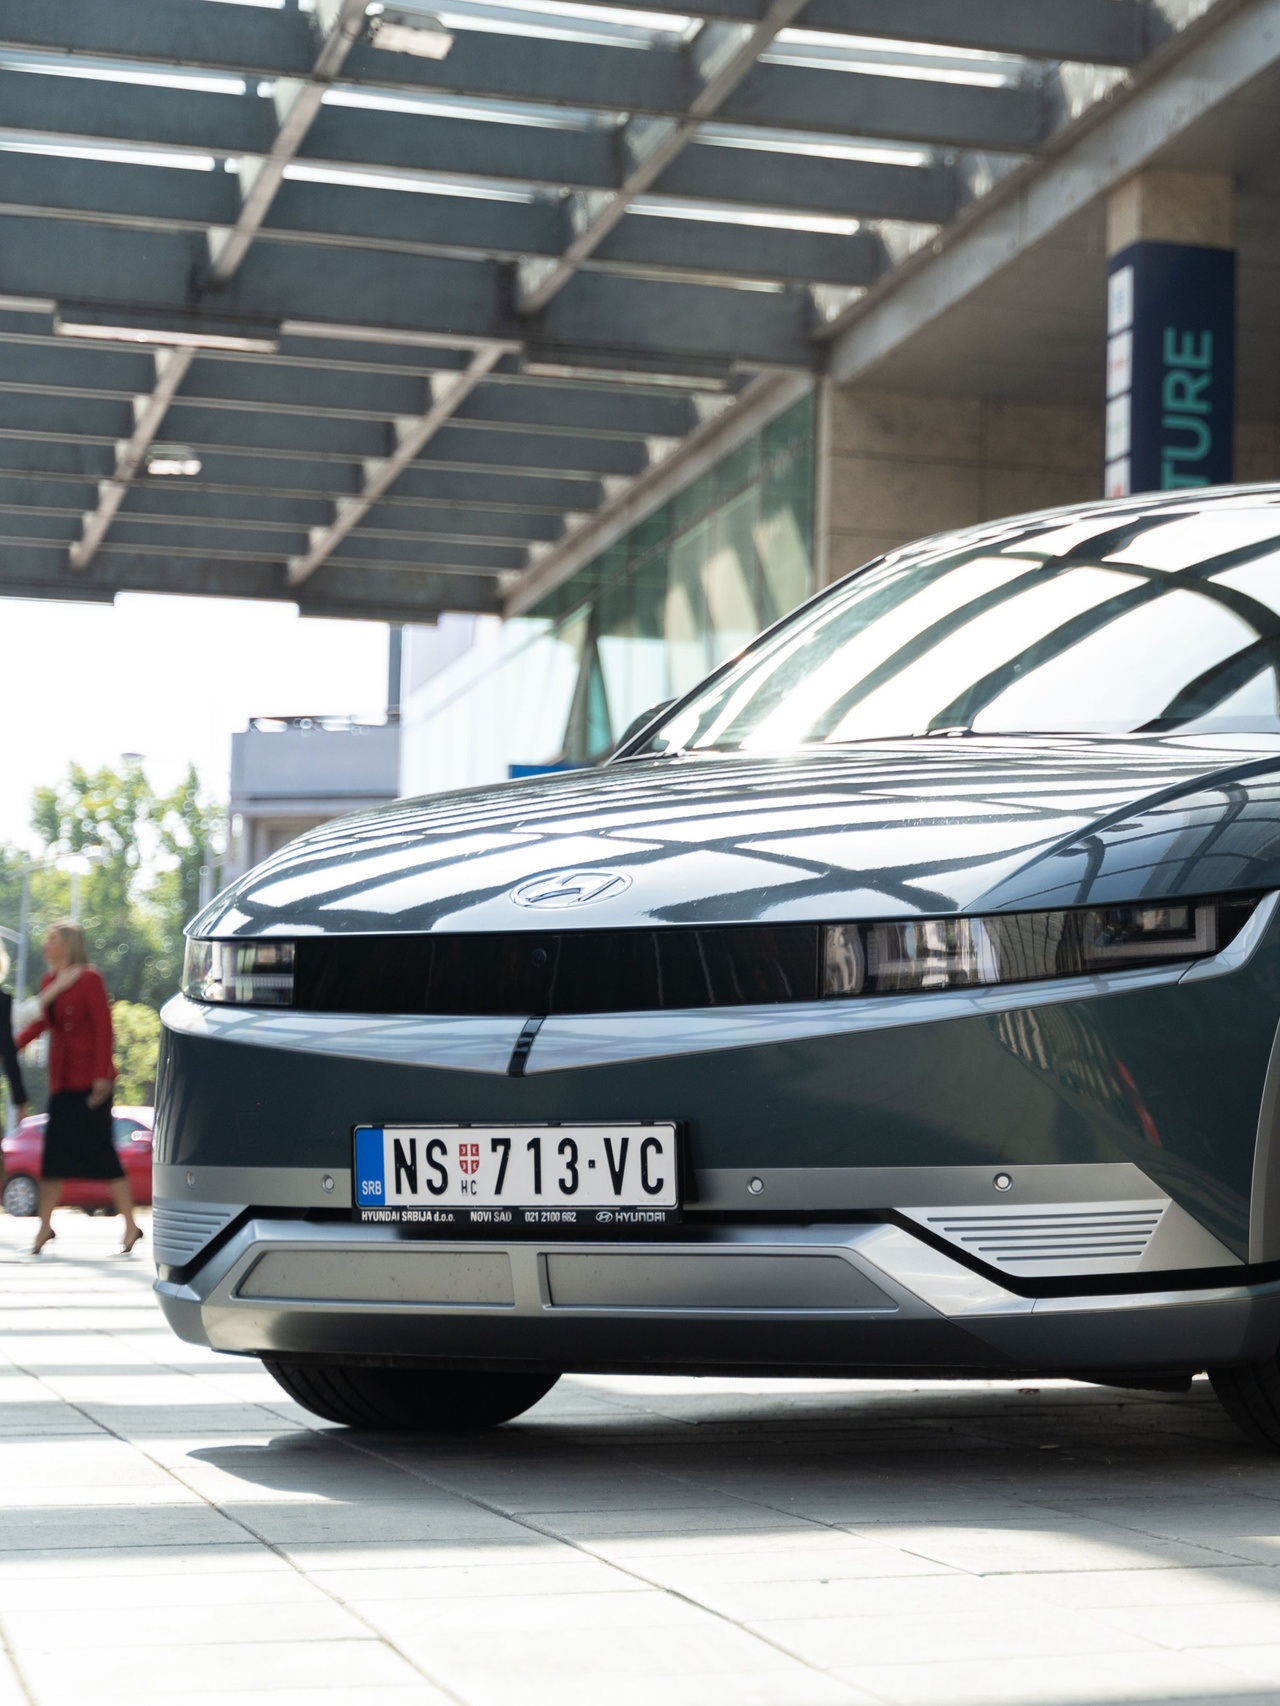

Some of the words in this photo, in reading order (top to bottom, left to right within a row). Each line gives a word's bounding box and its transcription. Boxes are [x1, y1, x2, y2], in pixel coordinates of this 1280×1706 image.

[392, 1137, 449, 1196] NS
[361, 1180, 382, 1196] SRB
[361, 1210, 400, 1222] HYUNDAI
[401, 1210, 432, 1222] SRBIJA
[433, 1210, 456, 1222] d.o.o.
[470, 1210, 492, 1222] NOVI
[493, 1211, 512, 1222] SAD
[524, 1211, 539, 1222] 021
[540, 1211, 561, 1222] 2100
[561, 1211, 577, 1222] 682
[615, 1211, 666, 1222] HYUNDAI
